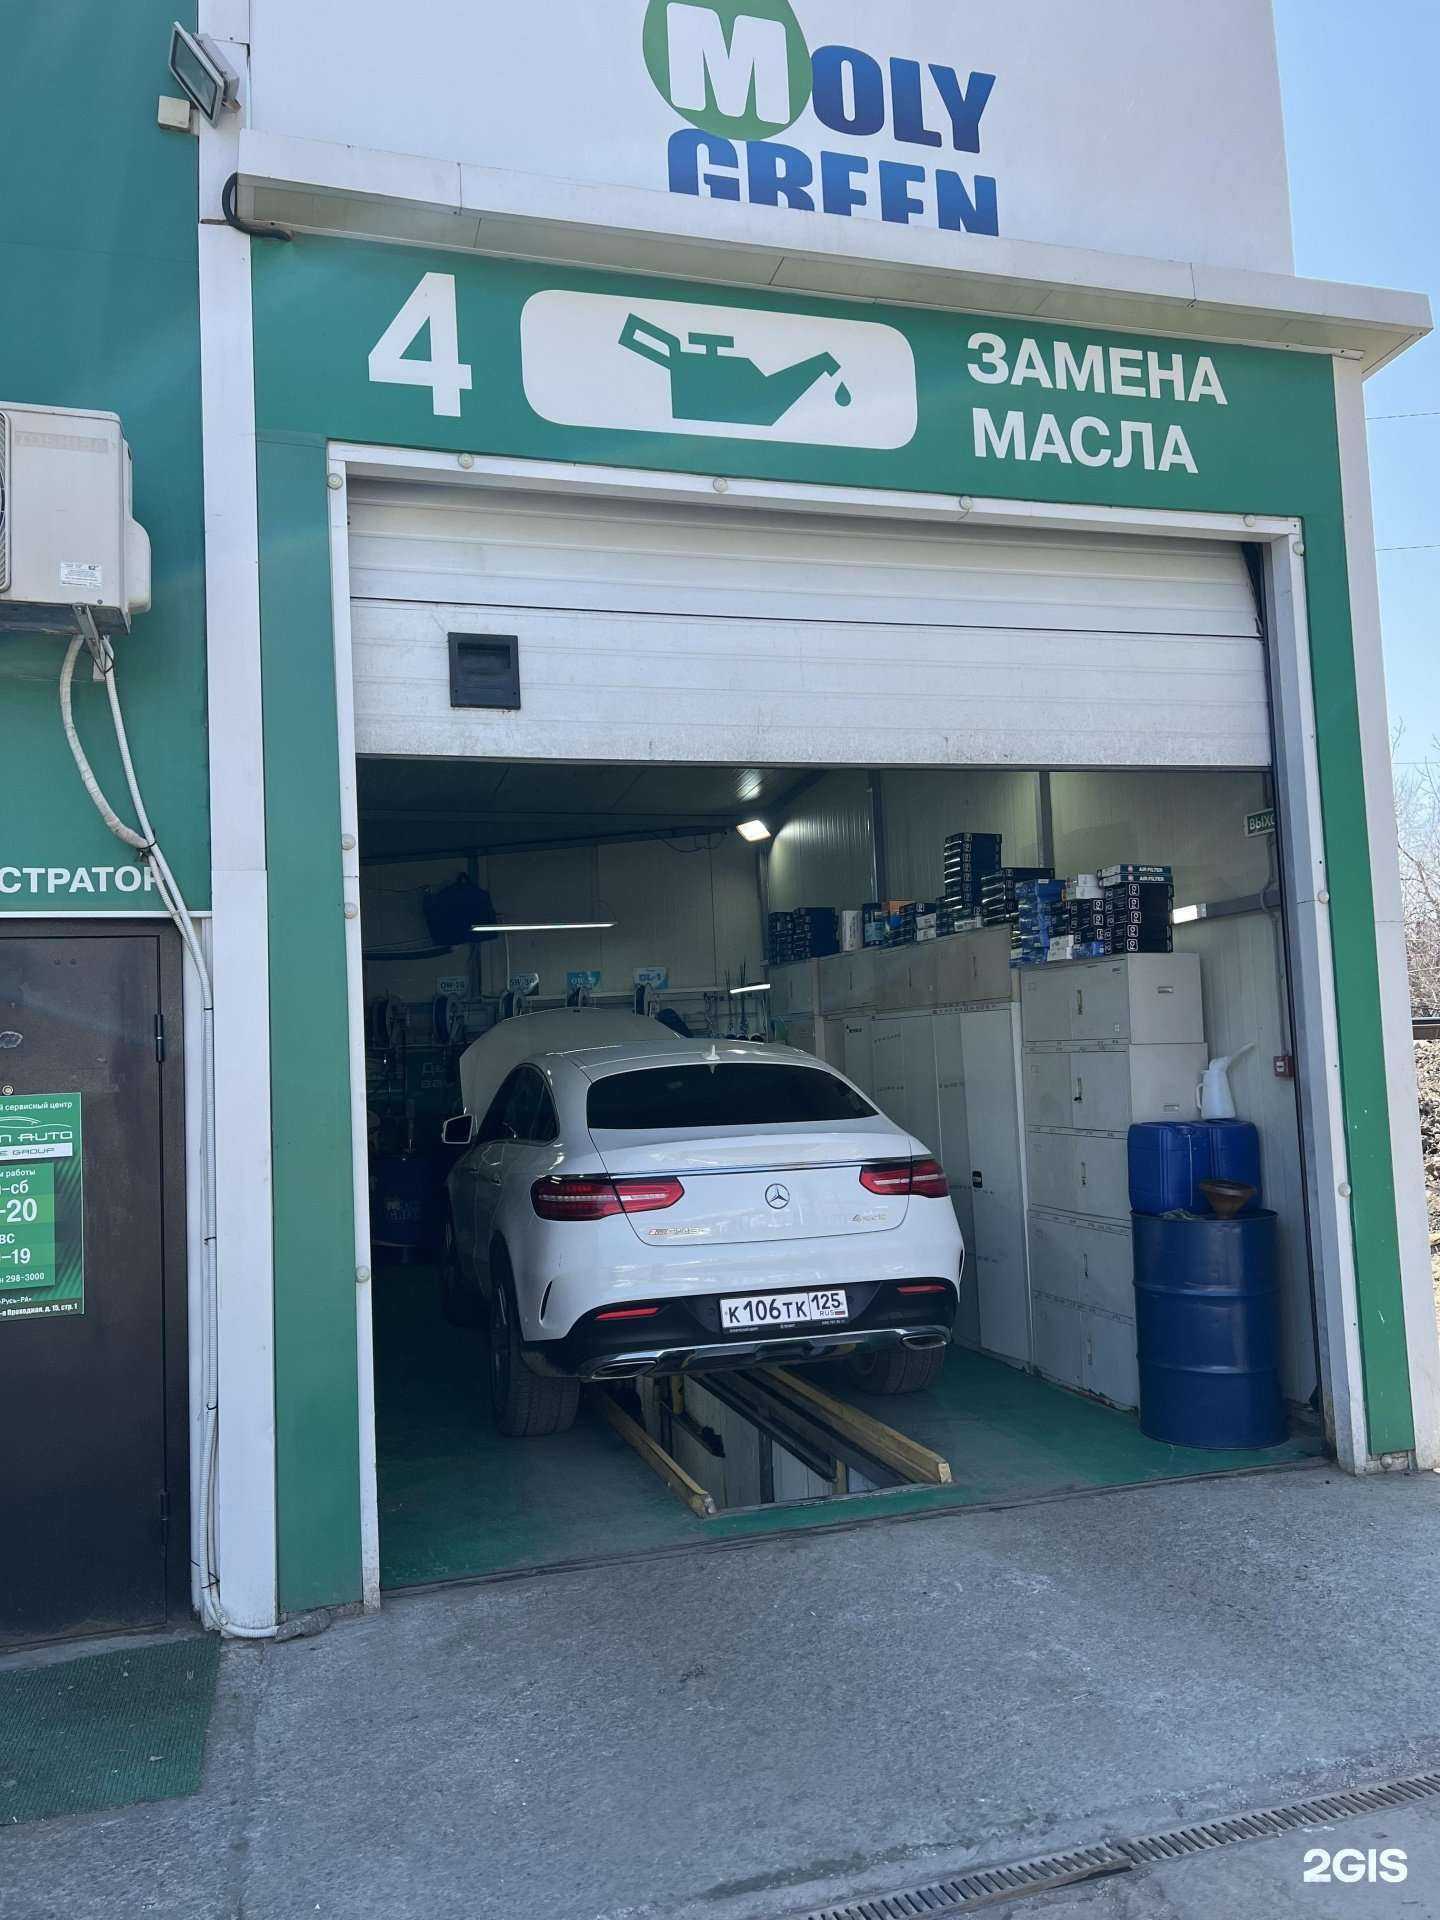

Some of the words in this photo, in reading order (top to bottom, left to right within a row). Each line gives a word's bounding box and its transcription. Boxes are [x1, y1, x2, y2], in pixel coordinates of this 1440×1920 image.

[667, 2, 996, 154] MOLY
[368, 271, 472, 417] 4
[967, 332, 1228, 405] ЗАМЕНА
[972, 407, 1199, 474] МАСЛА
[5, 1102, 49, 1111] сервисный
[49, 1101, 72, 1110] центр
[17, 1131, 72, 1142] AUTO
[12, 1147, 55, 1156] GROUP
[6, 1169, 36, 1178] работы
[6, 1272, 45, 1283] 298-3000
[811, 1292, 841, 1311] 125
